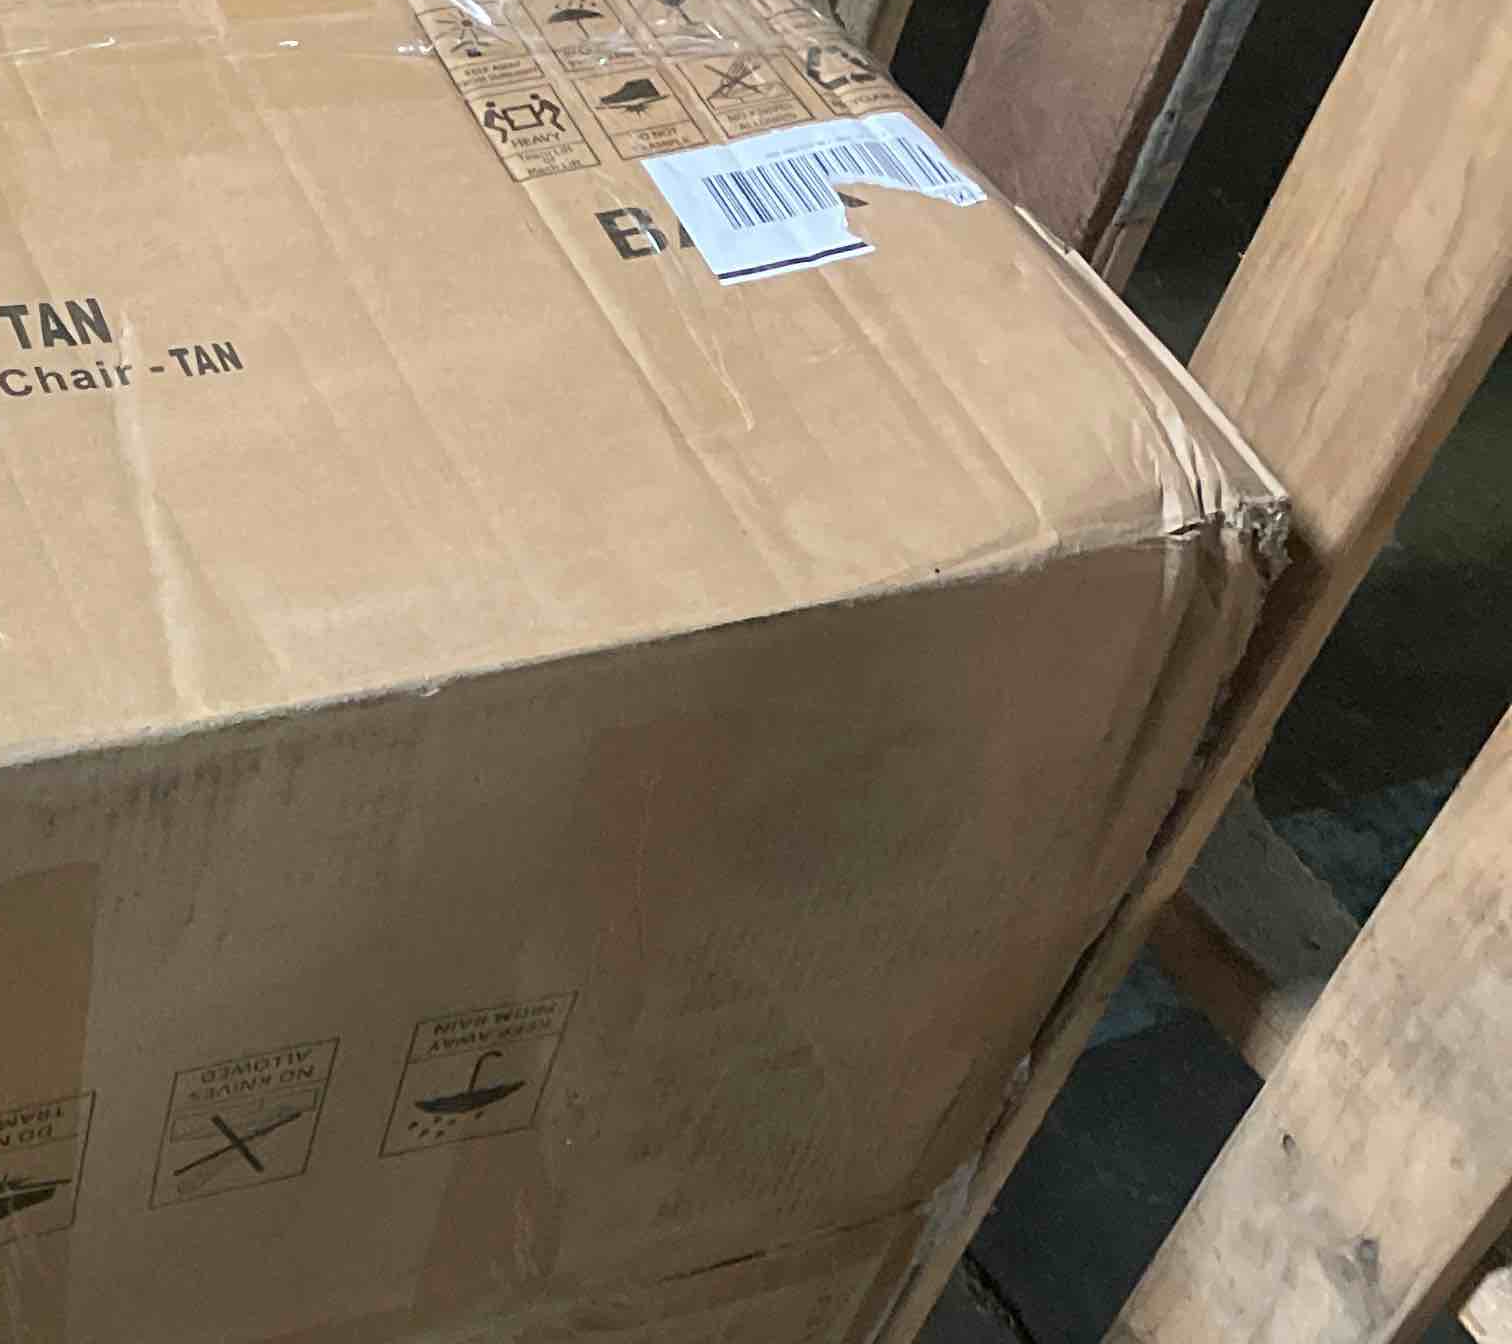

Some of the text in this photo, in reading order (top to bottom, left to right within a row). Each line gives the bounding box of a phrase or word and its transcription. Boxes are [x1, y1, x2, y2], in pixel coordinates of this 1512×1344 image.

[511, 132, 560, 148] HEAVY
[201, 1047, 313, 1084] ALLOWED
[189, 1064, 316, 1100] NO KNIVES
[18, 1122, 53, 1144] DO
